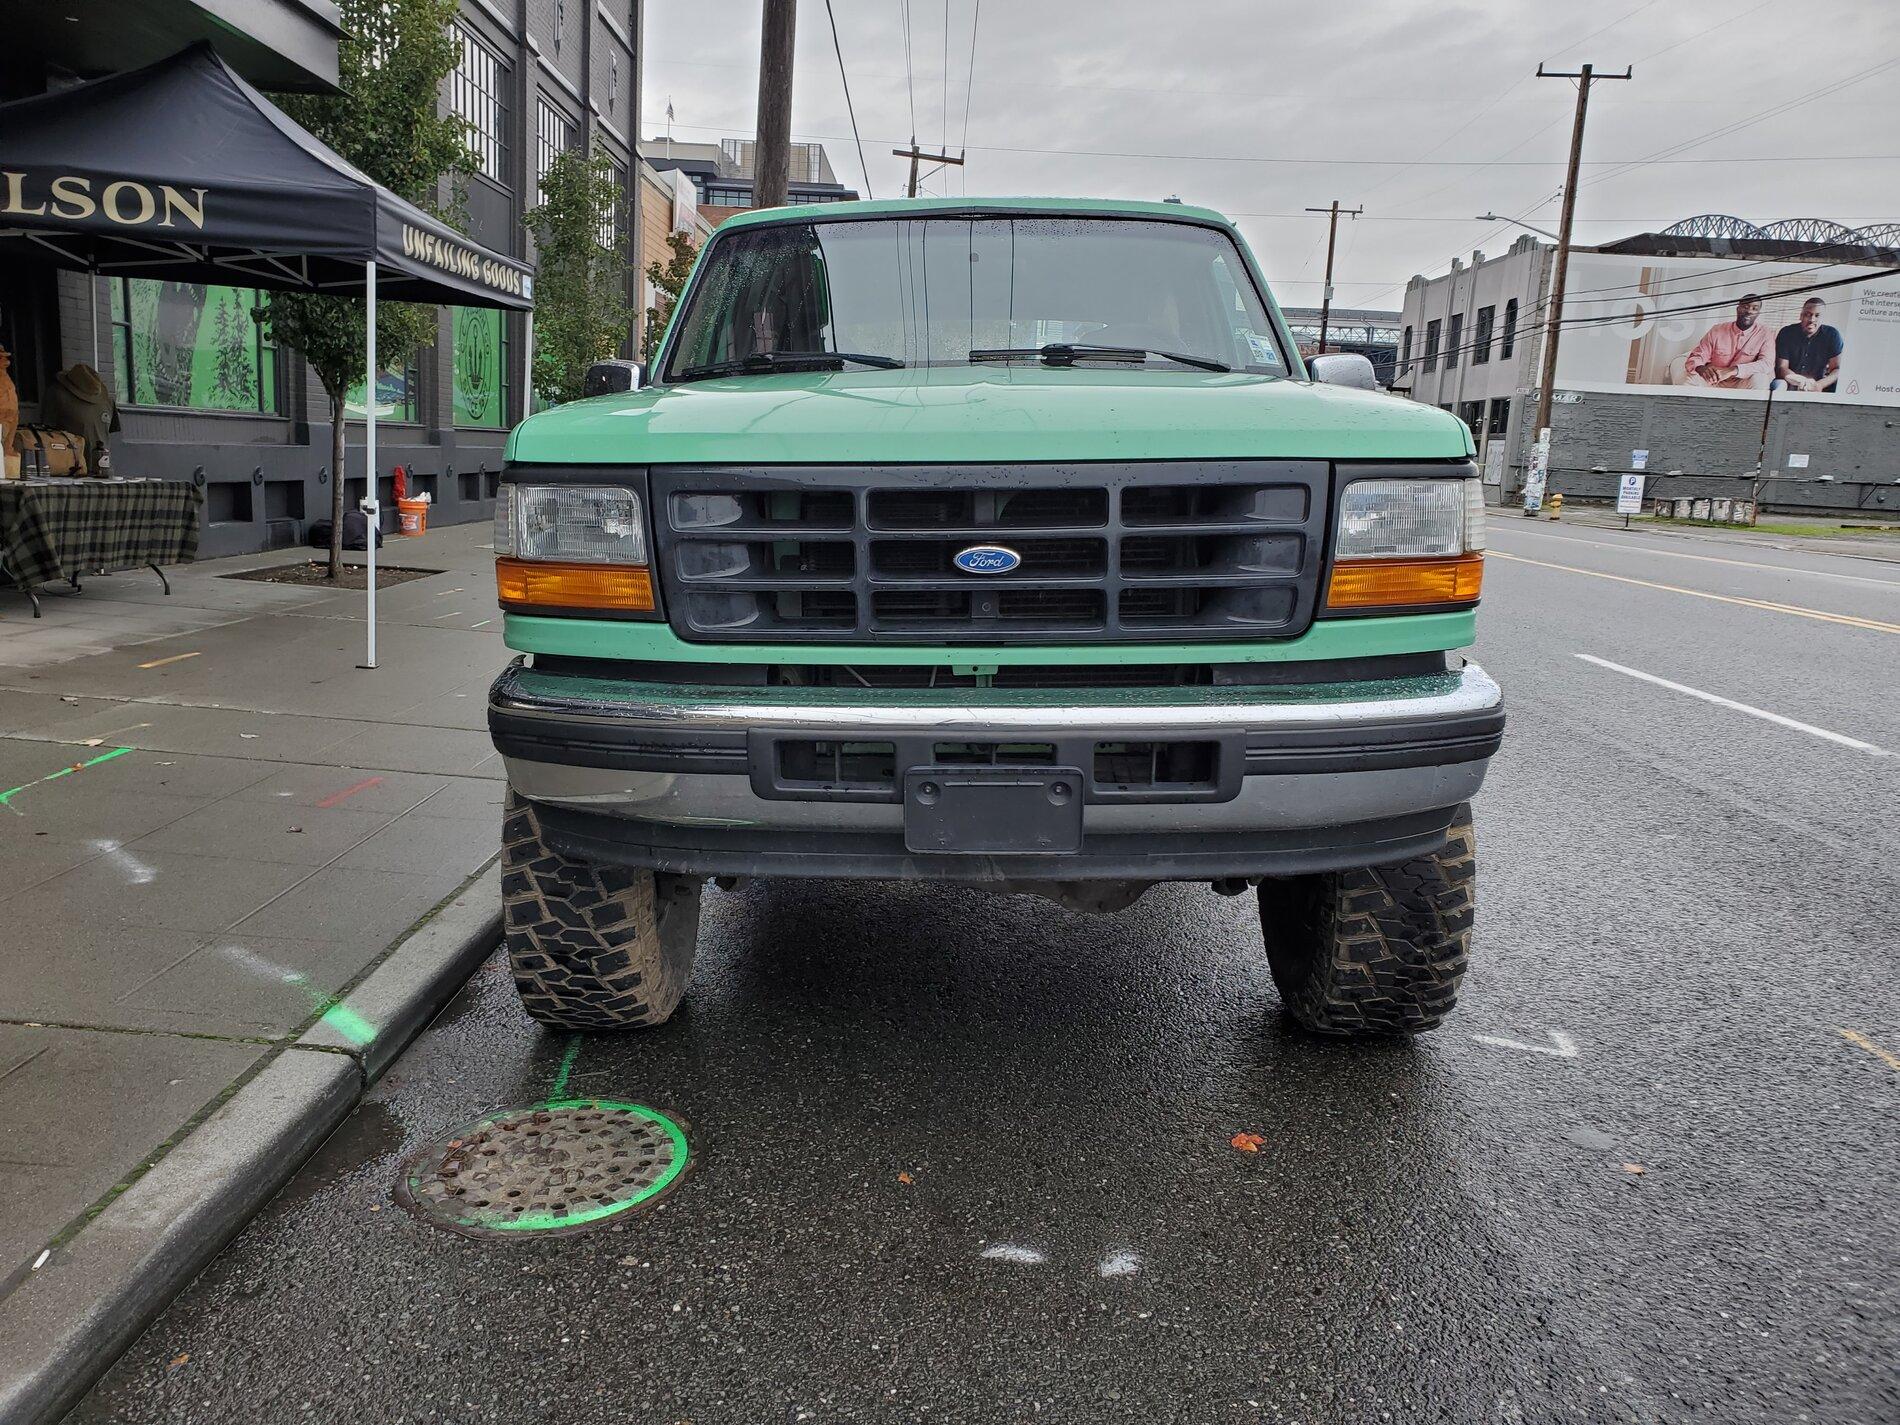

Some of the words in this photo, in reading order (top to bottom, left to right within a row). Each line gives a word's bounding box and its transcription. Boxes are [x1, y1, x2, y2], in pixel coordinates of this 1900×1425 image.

[1, 171, 209, 230] LSON
[402, 223, 480, 281] UNFAILING
[482, 259, 521, 295] GOODS
[1861, 298, 1875, 306] the
[1859, 308, 1887, 316] culture
[1875, 384, 1894, 393] Host
[969, 552, 1005, 567] Ford
